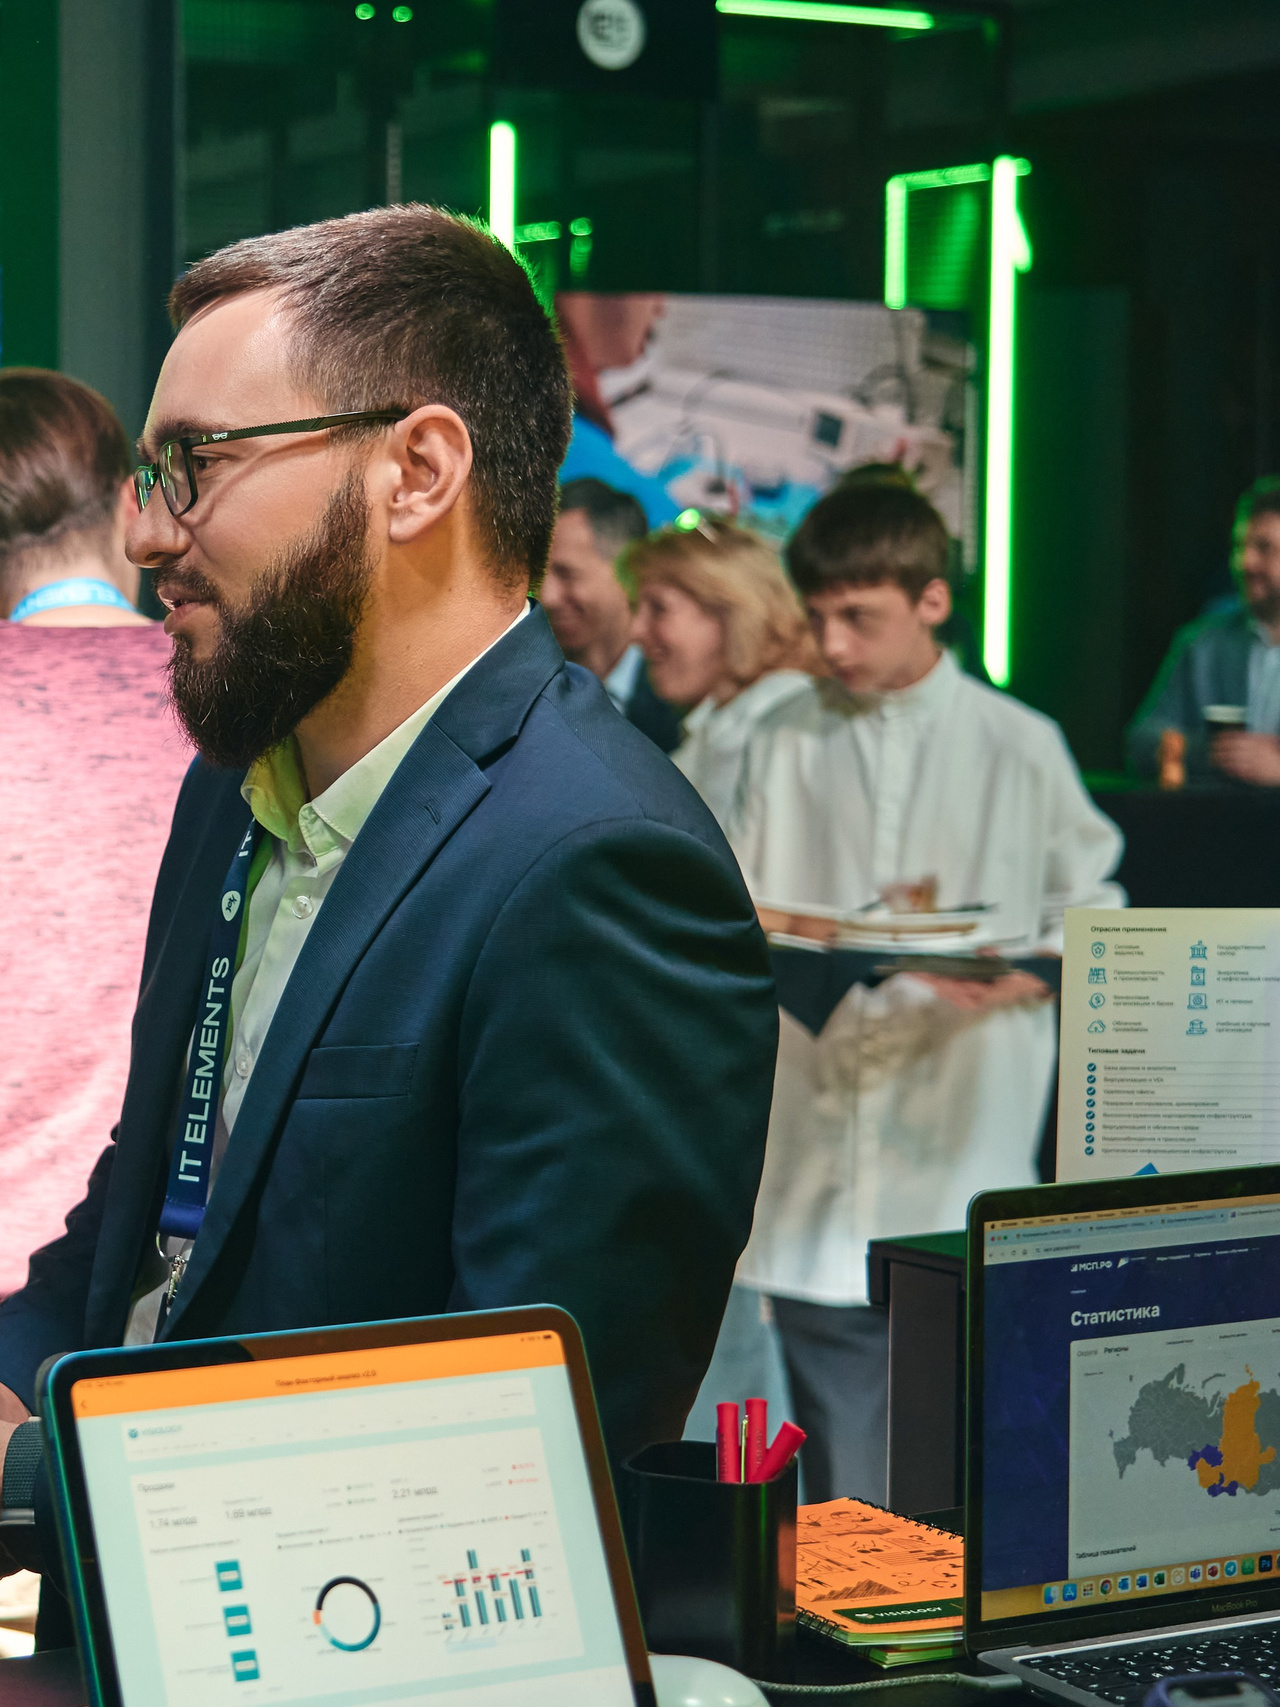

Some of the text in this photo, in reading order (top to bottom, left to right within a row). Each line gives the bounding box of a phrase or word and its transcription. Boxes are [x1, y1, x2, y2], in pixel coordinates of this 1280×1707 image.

[238, 830, 252, 857] IT
[178, 956, 230, 1182] IT ELEMENTS
[1079, 1260, 1113, 1272] МСП.РФ
[1071, 1305, 1160, 1326] Статистика
[875, 1606, 942, 1617] VISIOLOGY
[1212, 1599, 1258, 1613] MacBook Pro
